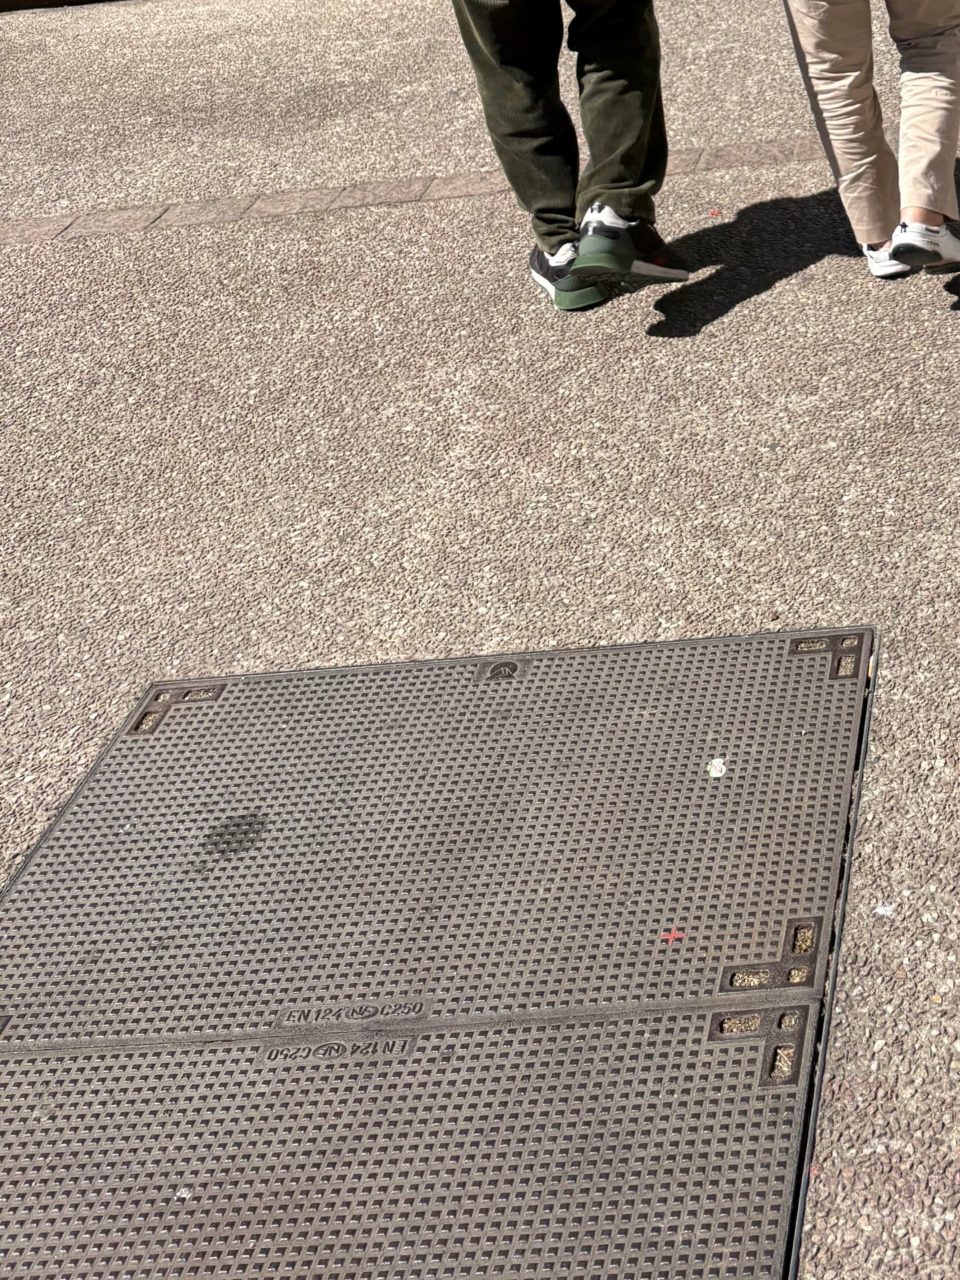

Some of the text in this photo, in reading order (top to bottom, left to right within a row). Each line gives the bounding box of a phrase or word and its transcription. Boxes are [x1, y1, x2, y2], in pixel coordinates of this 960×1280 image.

[286, 1009, 311, 1022] EN
[314, 1007, 343, 1020] 124
[380, 1001, 424, 1016] C250
[266, 1047, 312, 1061] C250
[351, 1041, 379, 1056] 124
[383, 1039, 408, 1054] EN
